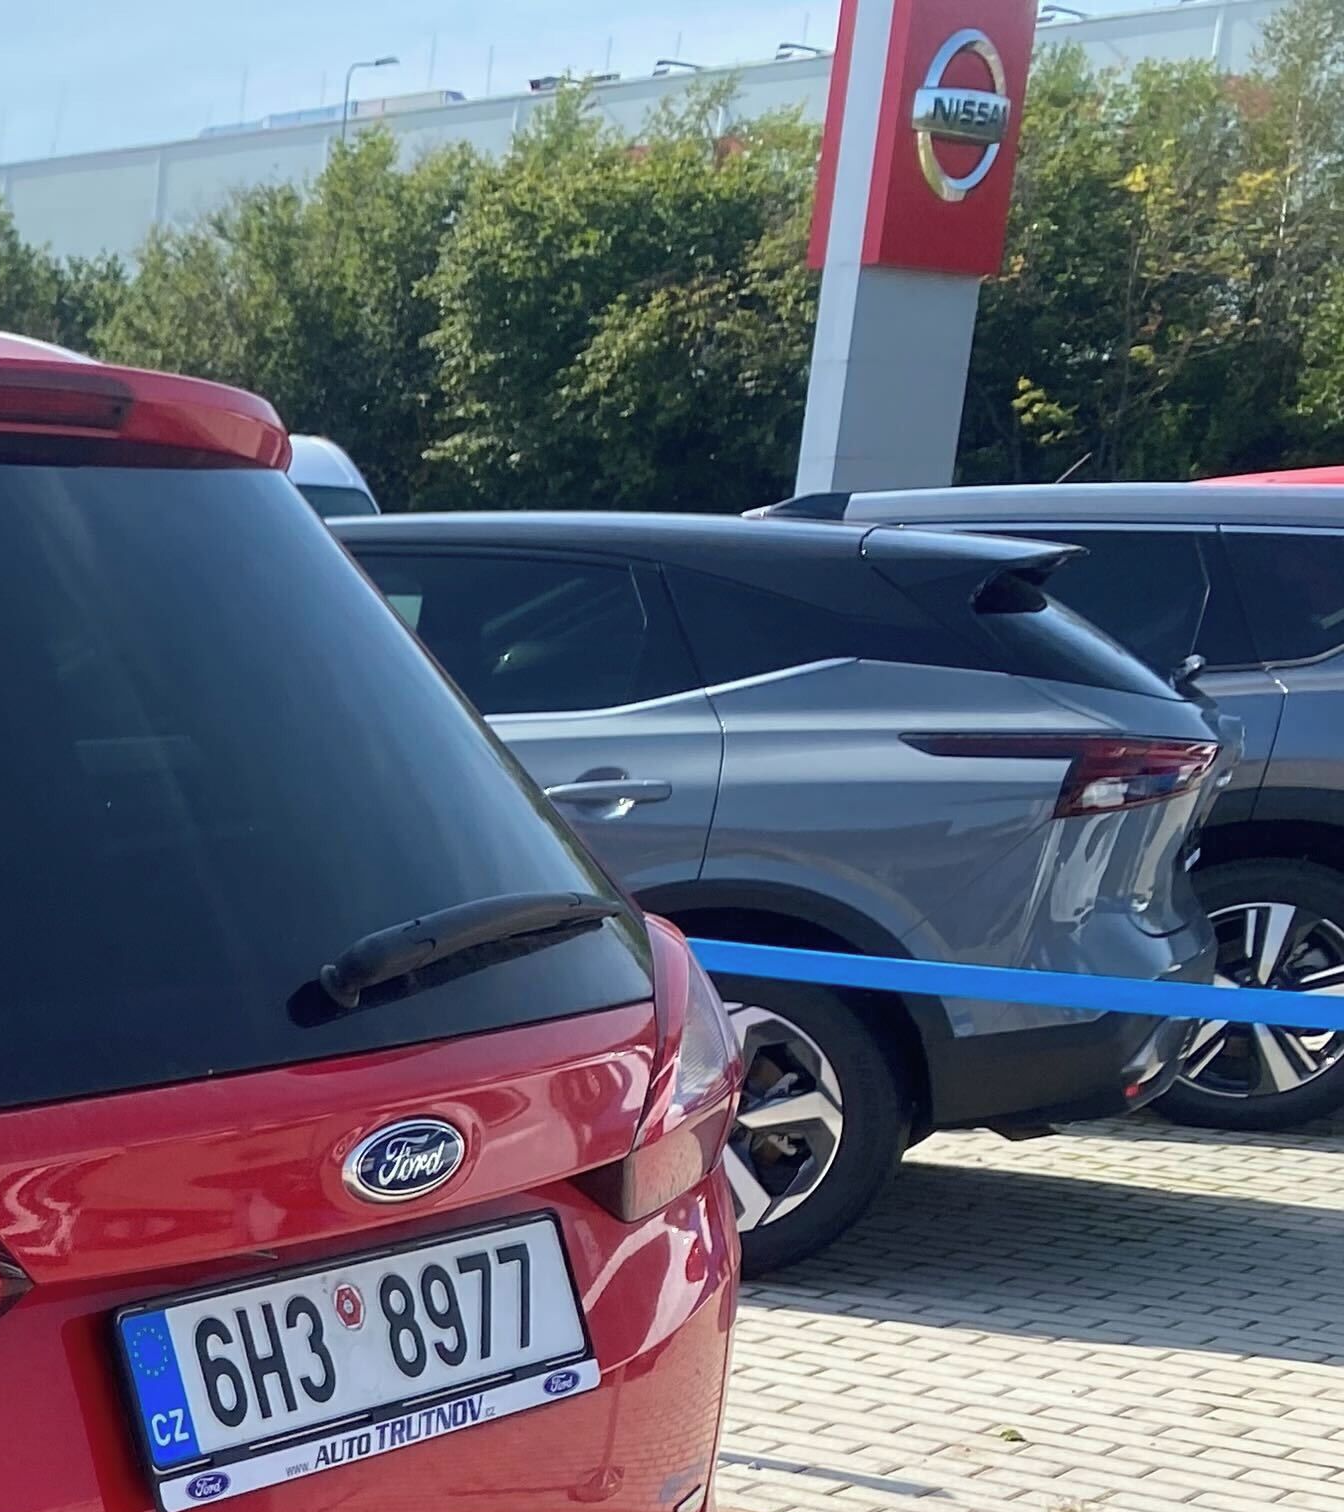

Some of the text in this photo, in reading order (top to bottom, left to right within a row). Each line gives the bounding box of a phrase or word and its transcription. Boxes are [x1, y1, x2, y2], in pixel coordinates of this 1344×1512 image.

[378, 1135, 444, 1186] Ford
[195, 1244, 531, 1428] 6H3 8977
[546, 1369, 577, 1393] Ford
[151, 1406, 190, 1447] CZ
[194, 1475, 223, 1499] Ford
